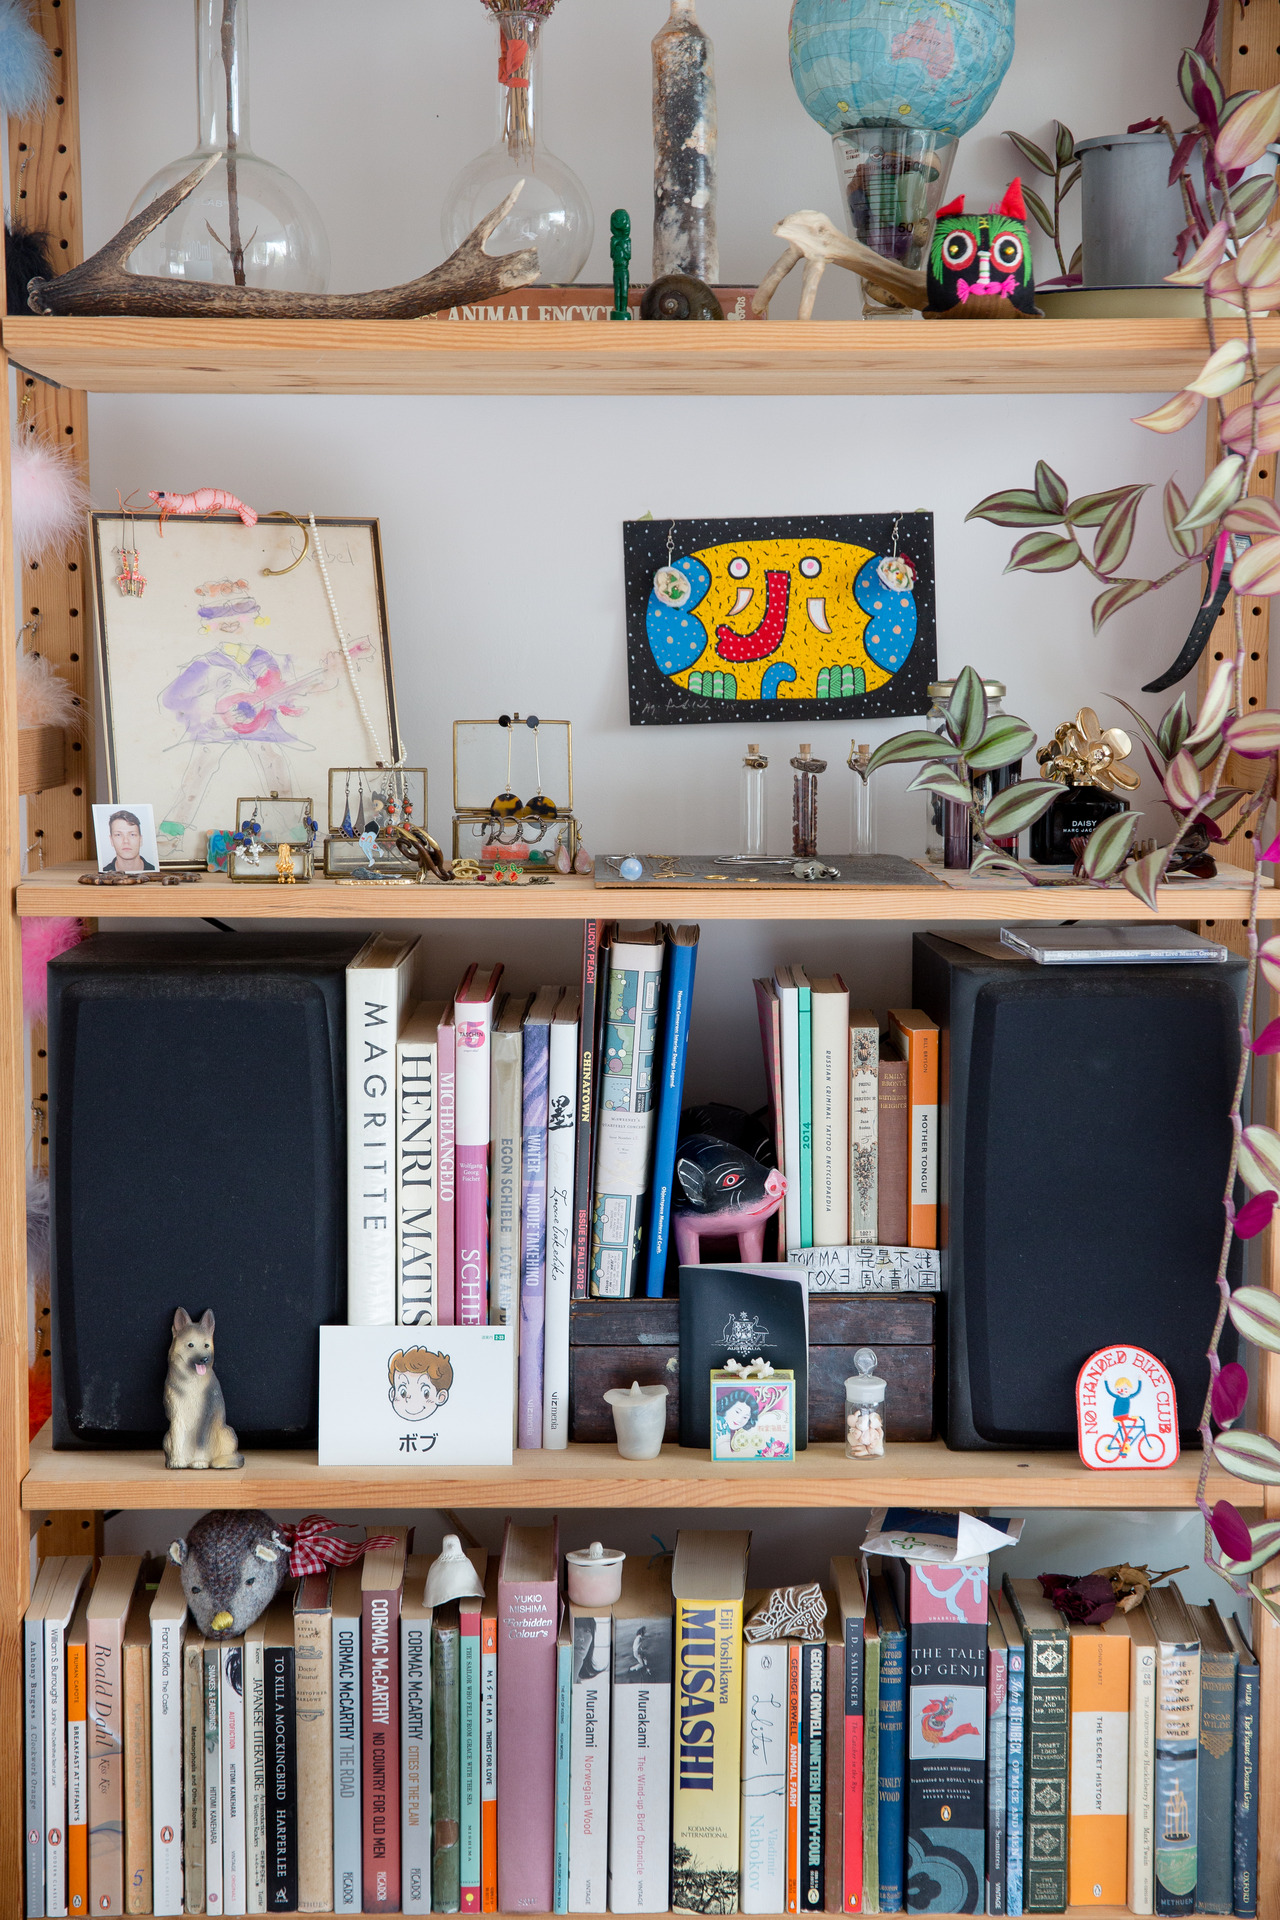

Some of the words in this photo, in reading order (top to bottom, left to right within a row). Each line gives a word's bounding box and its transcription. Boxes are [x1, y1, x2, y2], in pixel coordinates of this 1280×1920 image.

[898, 222, 914, 234] 50
[587, 922, 596, 952] LUCKY
[586, 954, 595, 984] PEACH
[581, 1051, 592, 1122] CHINATOWN
[363, 1001, 389, 1231] MAGRITTE
[401, 1052, 433, 1190] HENRI
[439, 1072, 454, 1202] MICHELANGELO
[802, 1121, 811, 1149] 2014
[920, 1114, 929, 1153] MOTHER
[501, 1138, 513, 1175] EGON
[527, 1134, 541, 1173] WATER
[920, 1154, 928, 1194] TONGUE
[500, 1178, 513, 1233] SCHIELE
[525, 1193, 542, 1228] INOUE
[578, 1209, 586, 1236] ISSUE
[577, 1247, 585, 1267] FALL
[578, 1237, 585, 1245] 5:
[499, 1247, 512, 1279] LOVE
[525, 1230, 541, 1286] TAKEHIKO
[576, 1268, 584, 1290] 2012
[499, 1283, 512, 1311] AND
[1132, 1353, 1166, 1387] BIKE
[1156, 1391, 1171, 1433] CLUB
[399, 1432, 439, 1452] ボブ
[513, 1594, 542, 1602] YUKIO
[371, 1599, 388, 1654] CORMAC
[508, 1628, 549, 1639] Colours
[719, 1608, 734, 1630] Eiji
[850, 1623, 859, 1632] J.
[161, 1627, 171, 1649] Franz
[407, 1630, 423, 1678] CORMAC
[850, 1635, 859, 1648] D.
[912, 1648, 942, 1660] THE
[948, 1648, 985, 1660] TALE
[28, 1640, 38, 1679] Anthony
[94, 1643, 112, 1696] Roald
[161, 1652, 171, 1676] Kafka
[275, 1656, 284, 1672] TO
[339, 1631, 353, 1679] CORMAC
[719, 1634, 734, 1705] Yoshikawa
[809, 1648, 822, 1691] GEORGE
[911, 1665, 932, 1676] OF
[938, 1664, 985, 1677] GENJI
[275, 1672, 285, 1703] KILL
[372, 1658, 389, 1725] McCARTHY
[850, 1652, 859, 1706] SALINGER
[29, 1682, 38, 1719] Burgess
[162, 1695, 170, 1715] Castle
[253, 1677, 265, 1727] JAPANESE
[275, 1705, 284, 1714] A
[339, 1681, 354, 1740] McCARTHY
[408, 1680, 423, 1740] McCARTHY
[679, 1607, 716, 1791] MUSASHI
[809, 1693, 822, 1738] ORWELL
[95, 1701, 113, 1746] Dahl
[585, 1689, 598, 1748] Murakami
[636, 1689, 650, 1749] Murakami
[790, 1698, 798, 1736] ORWELL
[1204, 1713, 1230, 1721] OSCAR
[372, 1732, 385, 1745] NO
[30, 1733, 38, 1779] Clockwork
[99, 1757, 110, 1776] Kiss
[253, 1730, 264, 1791] LITERATURE:
[275, 1715, 286, 1800] MOCKINGBIRD
[340, 1745, 354, 1766] THE
[372, 1748, 385, 1792] COUNTRY
[408, 1745, 419, 1770] CITIES
[637, 1756, 646, 1771] The
[790, 1744, 798, 1779] ANIMAL
[809, 1739, 821, 1792] NINETEEN
[74, 1772, 80, 1781] AT
[99, 1778, 110, 1795] Kiss
[340, 1768, 355, 1799] ROAD
[408, 1772, 419, 1783] OF
[408, 1785, 419, 1800] THE
[582, 1755, 594, 1806] Norwegian
[635, 1773, 646, 1810] Wind-up
[29, 1781, 38, 1810] Orange
[229, 1787, 237, 1818] KANEHARA
[373, 1794, 386, 1813] FOR
[373, 1816, 386, 1835] OLD
[408, 1801, 419, 1826] PLAIN
[583, 1808, 594, 1835] Wood
[637, 1813, 646, 1831] Bird
[808, 1794, 821, 1866] EIGHTY-FOUR
[276, 1810, 287, 1856] HARPER
[373, 1837, 386, 1859] MEN
[276, 1858, 287, 1877] LEE
[636, 1833, 646, 1875] Chronicle
[748, 1814, 765, 1891] Nabokov
[767, 1828, 778, 1876] Vladimir
[343, 1871, 353, 1904] PICADOR
[377, 1871, 386, 1901] PICADOR
[411, 1868, 421, 1901] PICADOR
